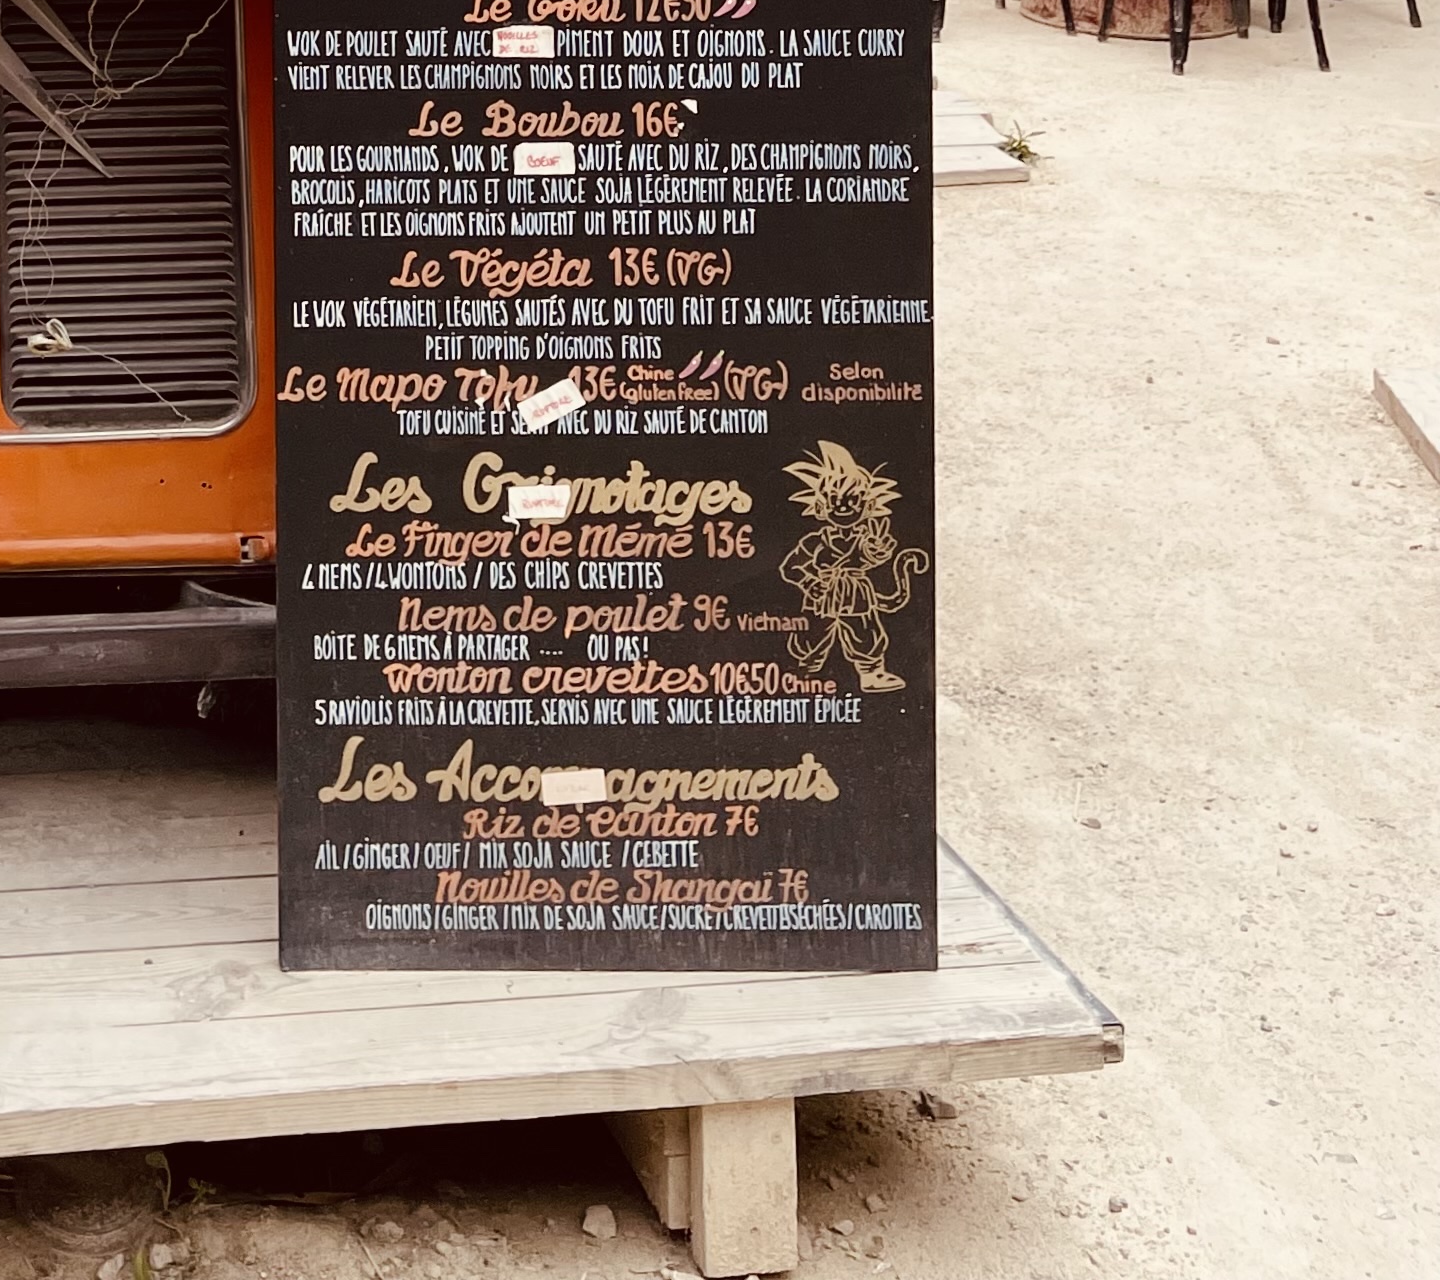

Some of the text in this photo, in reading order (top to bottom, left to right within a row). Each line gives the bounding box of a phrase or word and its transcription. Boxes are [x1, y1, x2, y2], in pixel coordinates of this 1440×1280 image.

[408, 100, 679, 137] Le Boubou 16€
[390, 247, 732, 299] Le Végéta 13€ (VG)
[829, 361, 884, 381] Selon
[346, 520, 755, 566] Le Finger de Mémé 13€
[398, 593, 809, 639] Nems de poulet 9€ Vietnam
[318, 735, 840, 815] Les Accoagnements
[463, 806, 759, 839] Riz de Canton 7€
